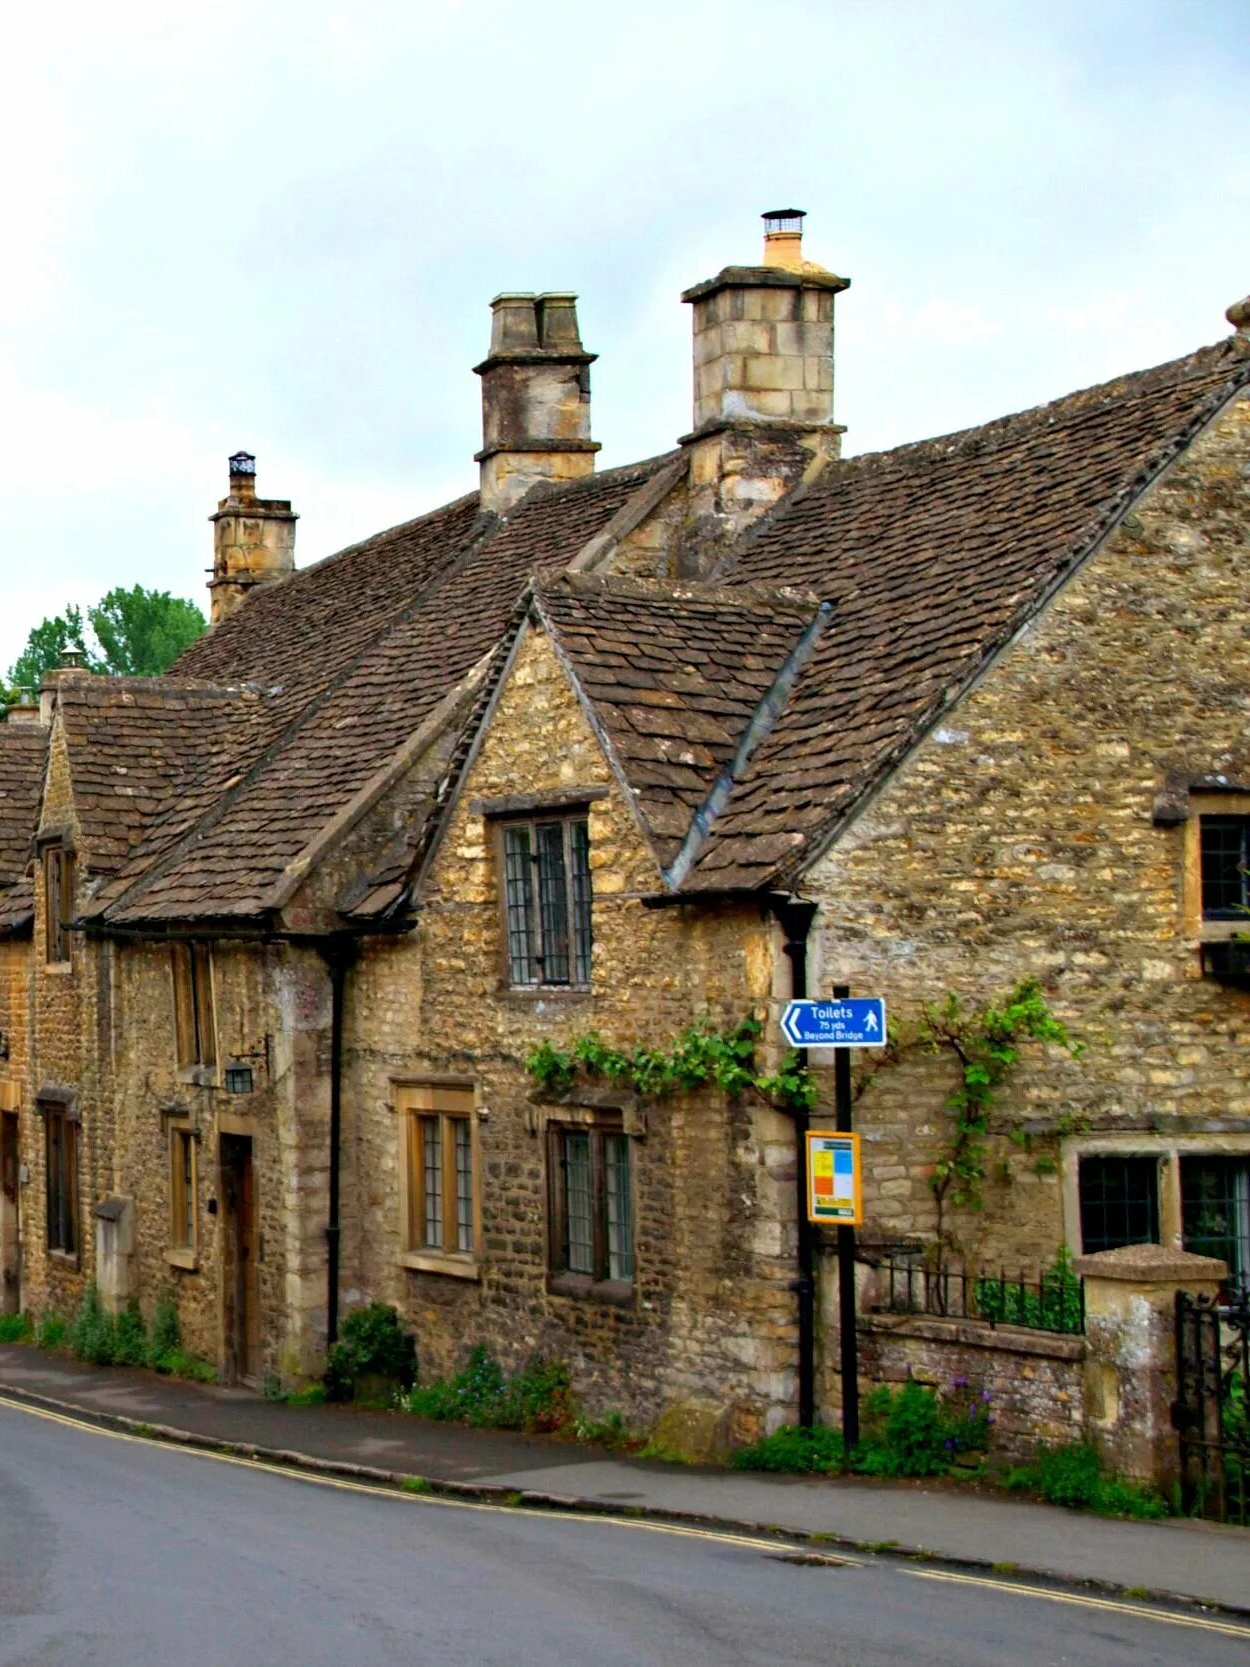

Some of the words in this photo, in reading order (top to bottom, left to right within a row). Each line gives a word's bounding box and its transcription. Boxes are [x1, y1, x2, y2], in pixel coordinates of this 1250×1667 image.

[811, 1007, 853, 1019] Toilets
[819, 1021, 830, 1030] 75
[831, 1021, 846, 1031] yds
[804, 1031, 834, 1041] Beyond
[836, 1030, 863, 1040] Bridge
